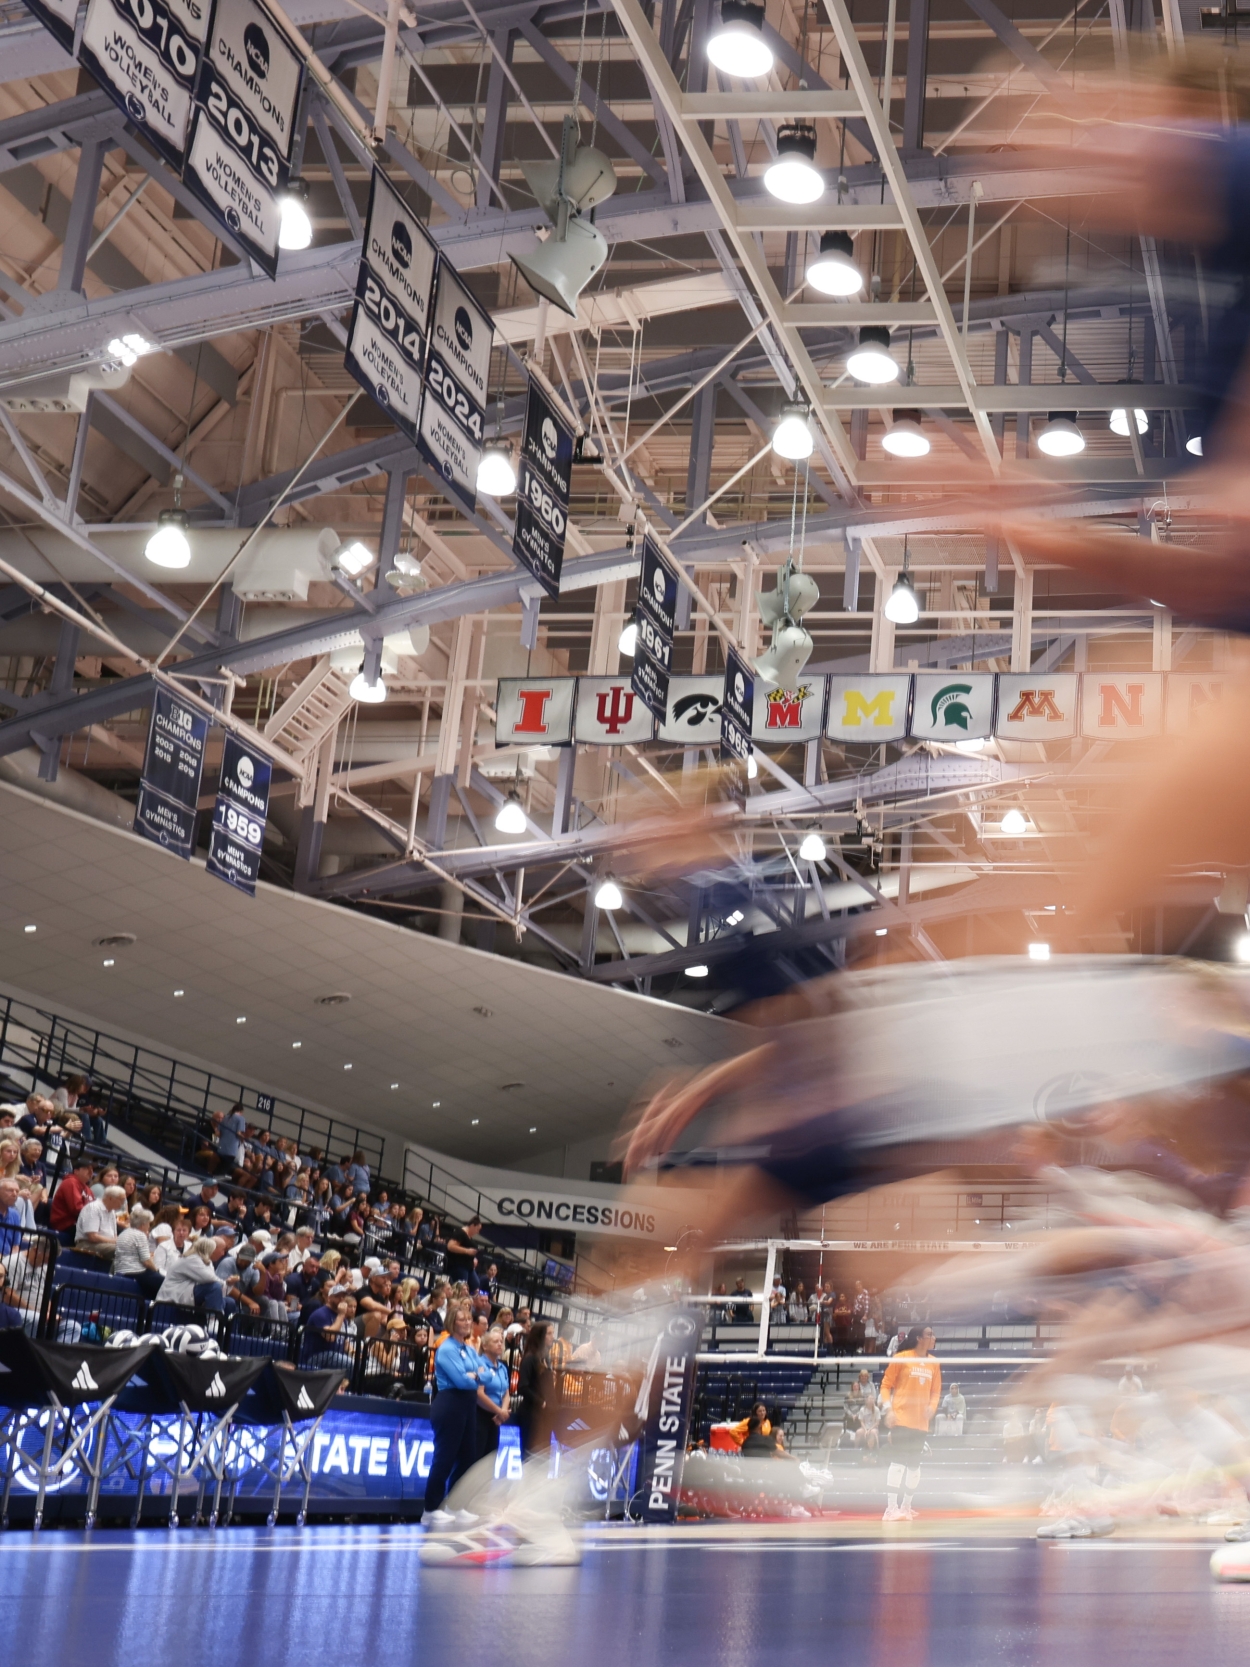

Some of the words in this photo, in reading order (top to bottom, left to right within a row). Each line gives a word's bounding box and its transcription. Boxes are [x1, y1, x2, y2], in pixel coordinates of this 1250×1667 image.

[118, 0, 197, 76] 010
[245, 41, 270, 73] NCAA
[104, 36, 176, 128] VOLLEYBALL
[113, 30, 170, 102] WOMEN'S
[218, 38, 285, 133] CHAMPIONS
[207, 81, 279, 186] 2013
[205, 162, 266, 235] VOLLEYBALL
[214, 152, 262, 212] WOMEN'S
[391, 236, 412, 266] NCAA
[371, 238, 425, 313] CHAMPIONS
[365, 277, 420, 360] 2014
[455, 321, 473, 346] NCAA
[362, 348, 408, 405] VOLLEYBALL
[370, 337, 404, 386] WOMEN'S
[436, 325, 484, 391] CHAMPIONS
[429, 360, 482, 440] 2024
[430, 426, 469, 478] VOLLEYBALL
[437, 418, 466, 460] WOMEN'S
[524, 471, 565, 535] 1960
[641, 618, 670, 666] 1961
[765, 700, 802, 730] M
[840, 690, 896, 728] M
[1007, 689, 1065, 723] M
[1098, 683, 1146, 728] N
[154, 747, 172, 764] 2015
[155, 734, 174, 753] 2003
[156, 714, 202, 751] CHAMPIONS
[724, 718, 749, 760] 1965
[145, 810, 185, 838] GYMNASTICS
[157, 804, 178, 823] MEN'S
[218, 804, 262, 845] 1959
[227, 845, 245, 862] MEN'S
[498, 1196, 656, 1234] CONCESSIONS
[853, 1242, 868, 1250] WE
[870, 1242, 890, 1250] ARE
[659, 1355, 687, 1434] STATE
[649, 1436, 678, 1512] PENN
